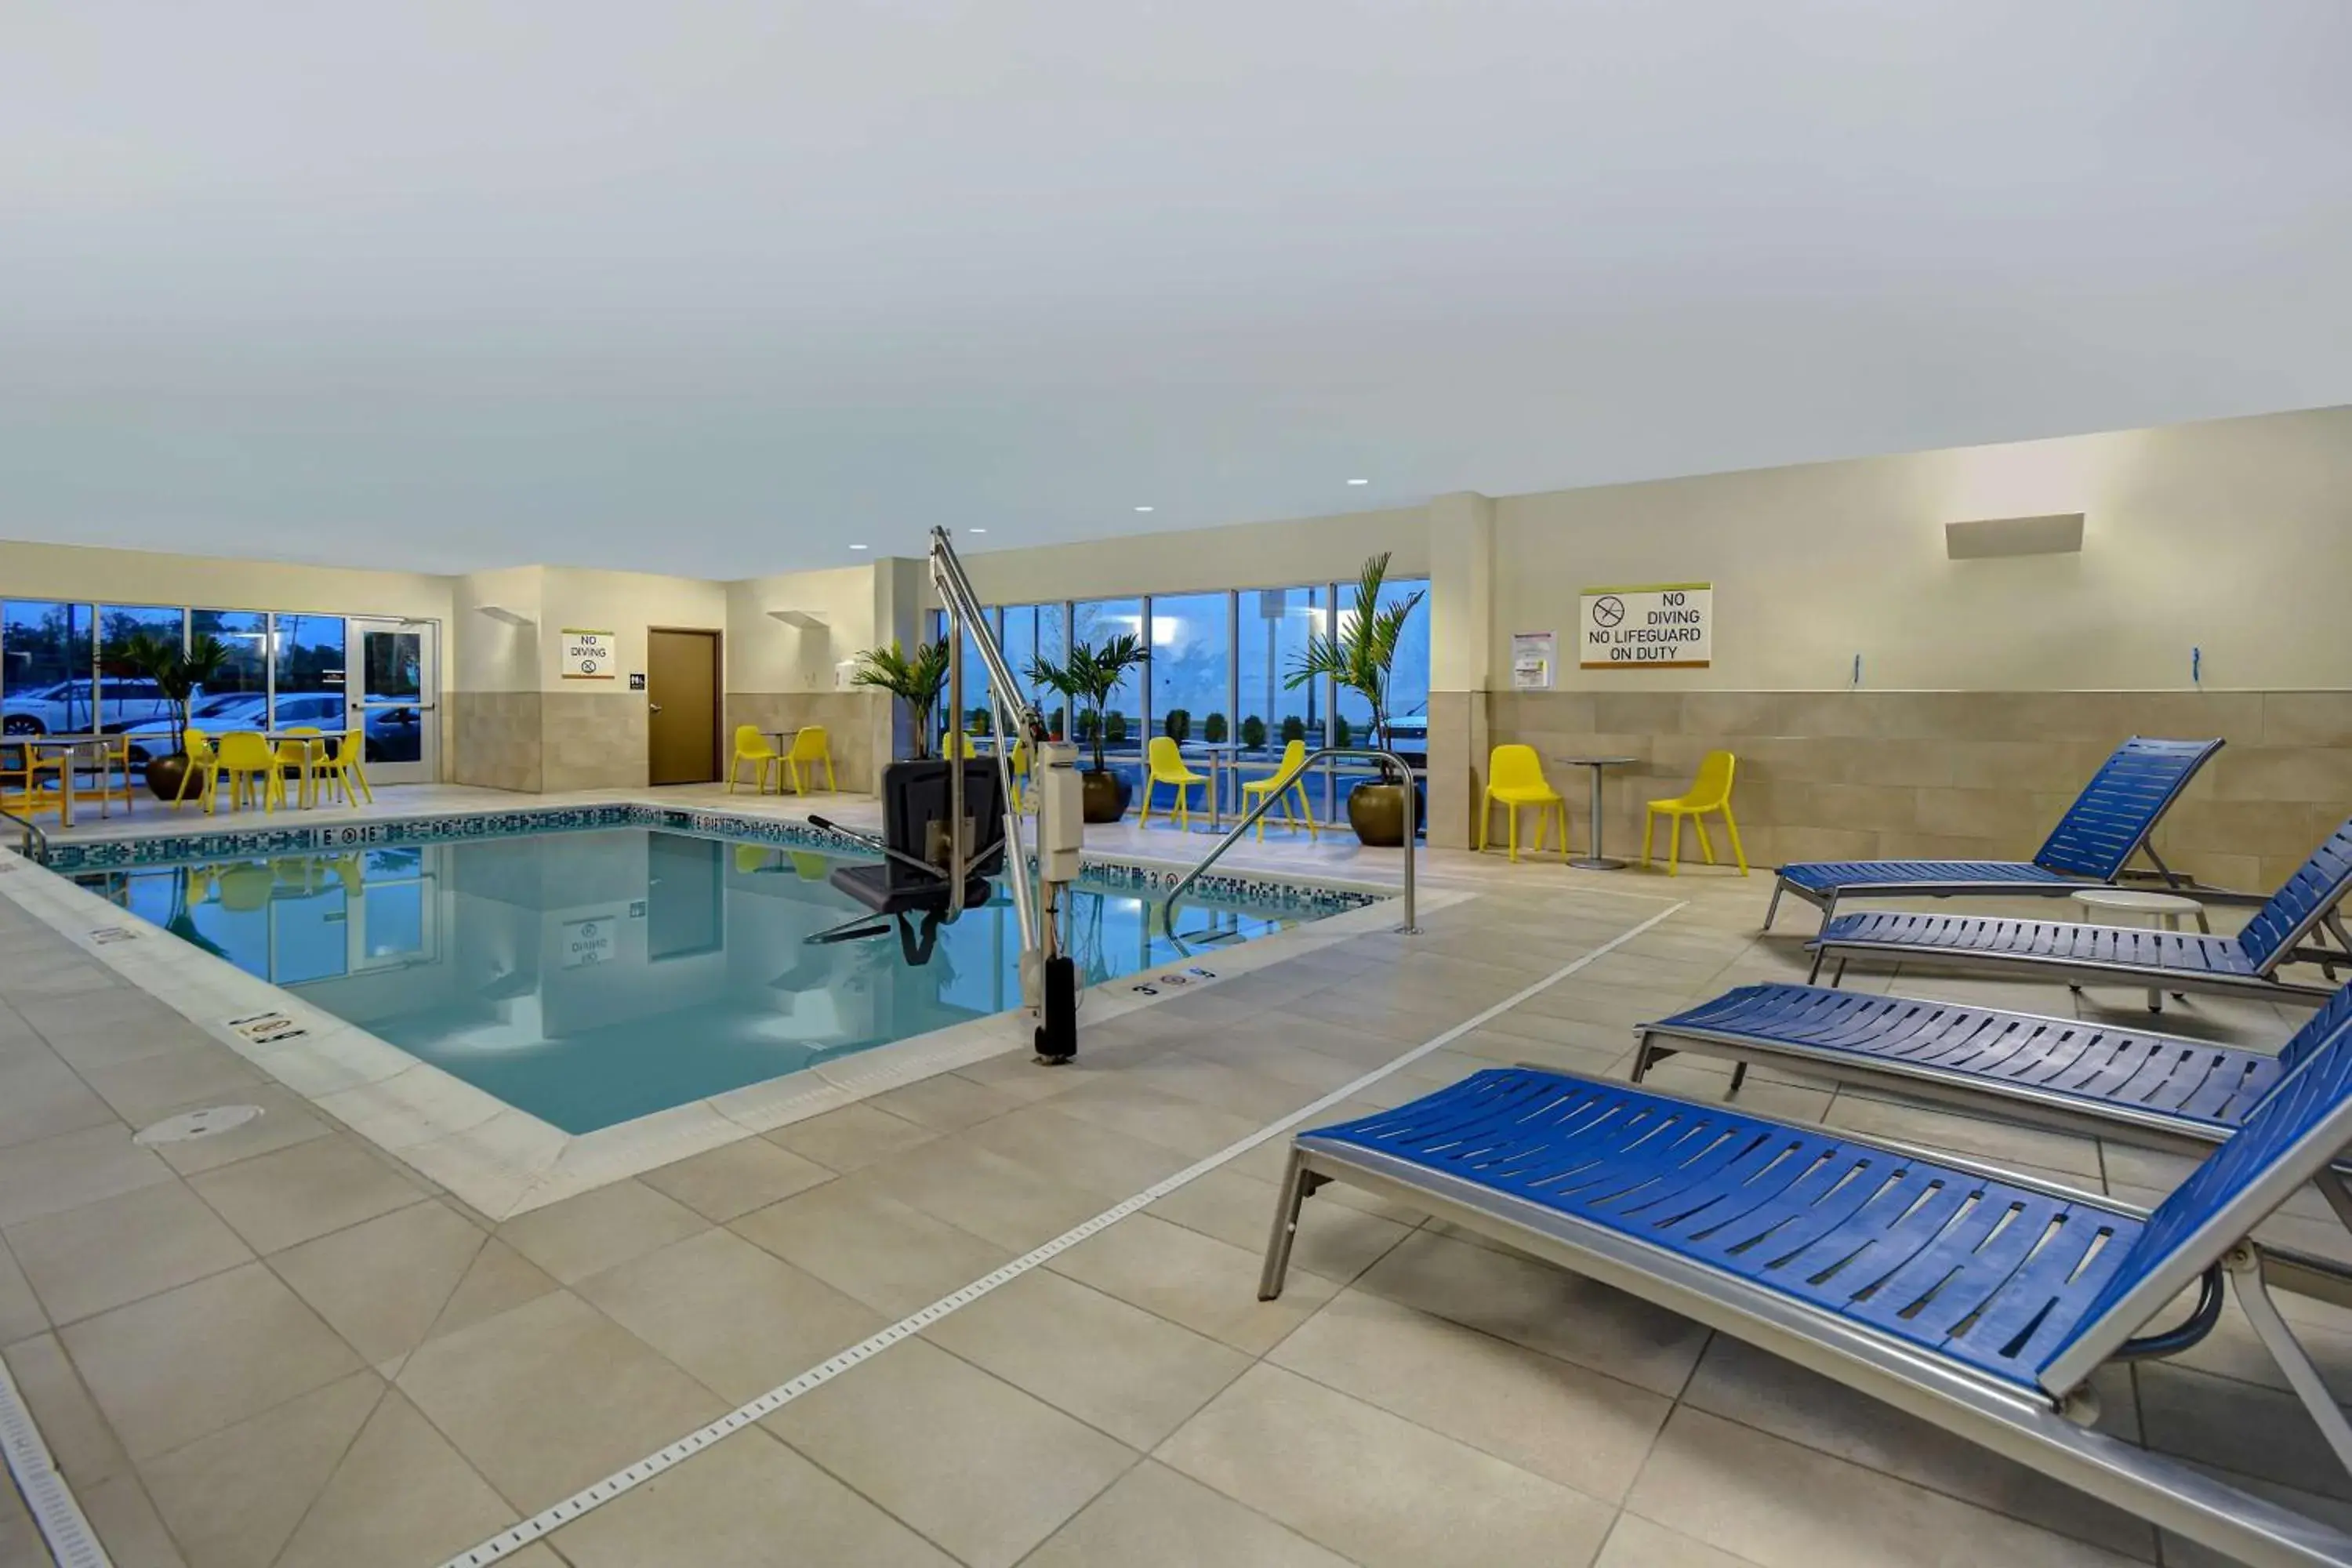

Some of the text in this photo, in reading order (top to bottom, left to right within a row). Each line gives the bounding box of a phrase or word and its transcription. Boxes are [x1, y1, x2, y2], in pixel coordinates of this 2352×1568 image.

[1663, 593, 1686, 607] NO
[1647, 610, 1700, 625] DIVING
[581, 636, 597, 645] NO
[1589, 628, 1701, 644] NO LIFEGUARD
[571, 647, 607, 658] DIVING
[1611, 646, 1679, 660] ON DUTY
